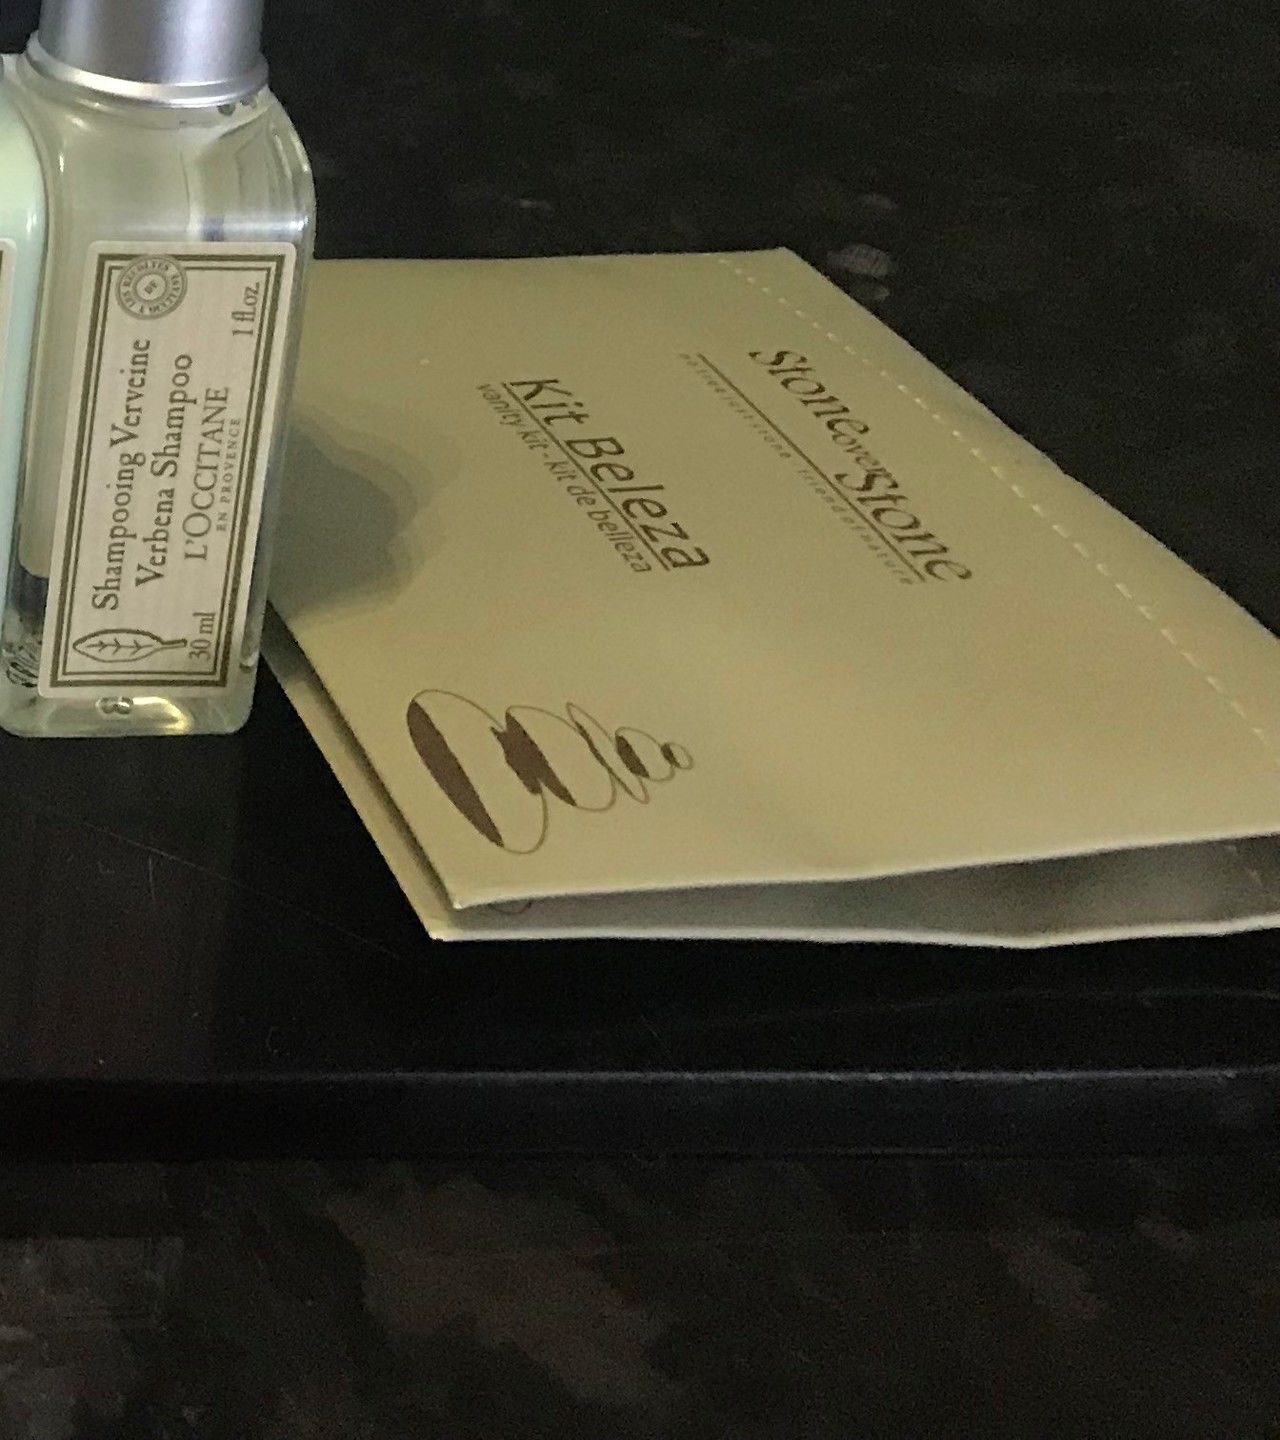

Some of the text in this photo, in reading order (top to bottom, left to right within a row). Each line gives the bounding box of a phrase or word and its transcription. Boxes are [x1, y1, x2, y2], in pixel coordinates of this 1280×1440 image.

[92, 339, 151, 611] Shampooing Verveine
[135, 355, 198, 586] Verbena Shampoo
[182, 387, 229, 560] L'OCCITANE
[216, 418, 241, 531] EN PROVENCE
[477, 383, 527, 428] vanity
[518, 429, 550, 451] kit
[544, 459, 577, 482] kit
[565, 485, 597, 508] de
[586, 509, 653, 574] belleza
[509, 378, 711, 569] Kit Beleza
[189, 612, 216, 660] 30 ml
